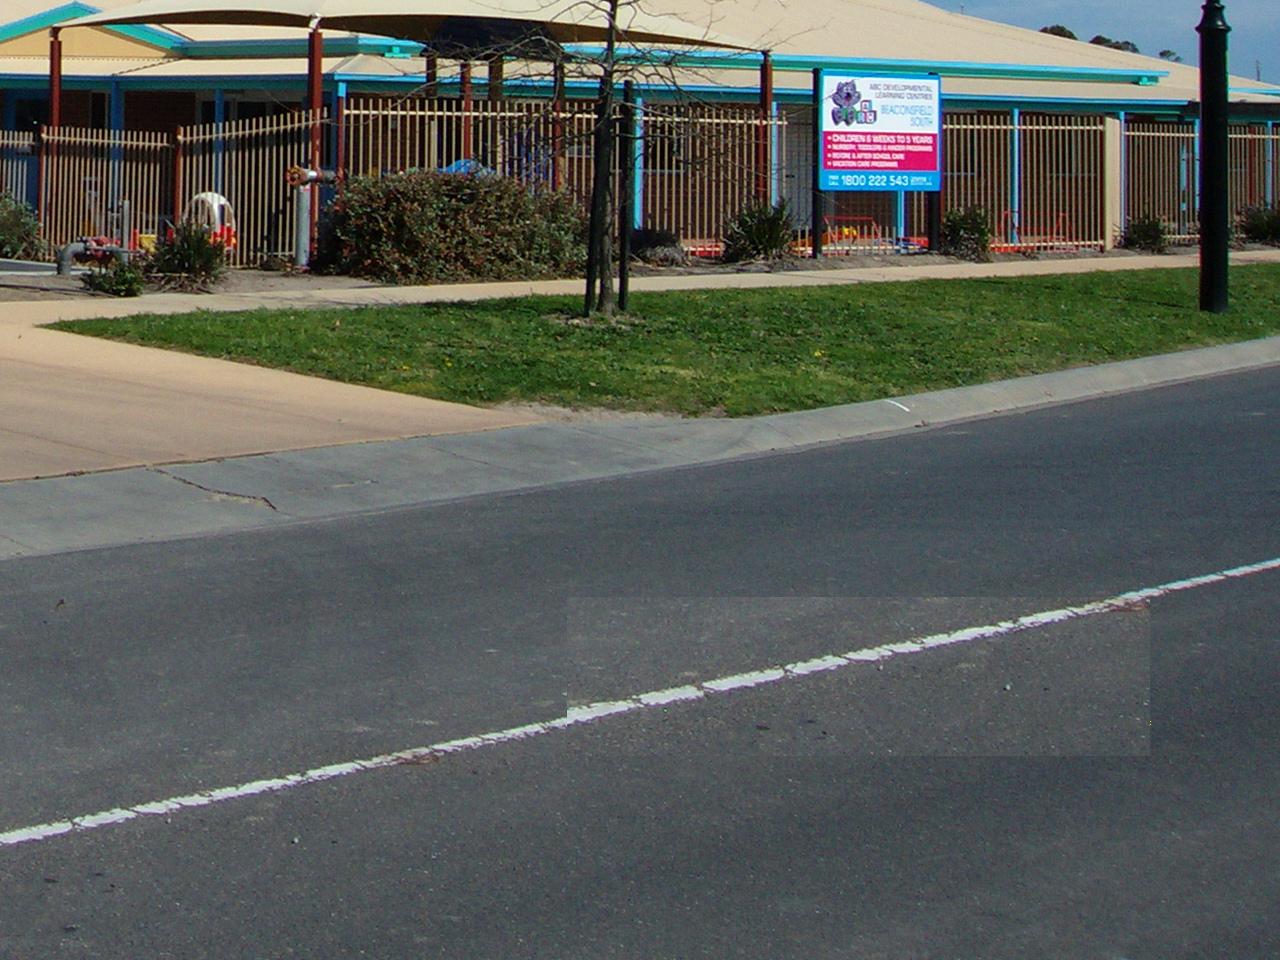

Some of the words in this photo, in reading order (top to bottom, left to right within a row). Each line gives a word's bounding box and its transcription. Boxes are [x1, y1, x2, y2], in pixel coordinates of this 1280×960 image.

[869, 83, 882, 91] ABC
[883, 83, 933, 92] DEVELOPMENTAL
[875, 91, 905, 100] LEARNING
[906, 92, 933, 101] CENTRES
[880, 104, 933, 116] BEACONSFIELD
[832, 134, 866, 143] CHILDREN
[872, 135, 896, 144] WEEKS
[912, 136, 933, 145] YEARS
[841, 174, 866, 186] 1800
[868, 174, 887, 187] 222
[889, 175, 909, 187] 543
